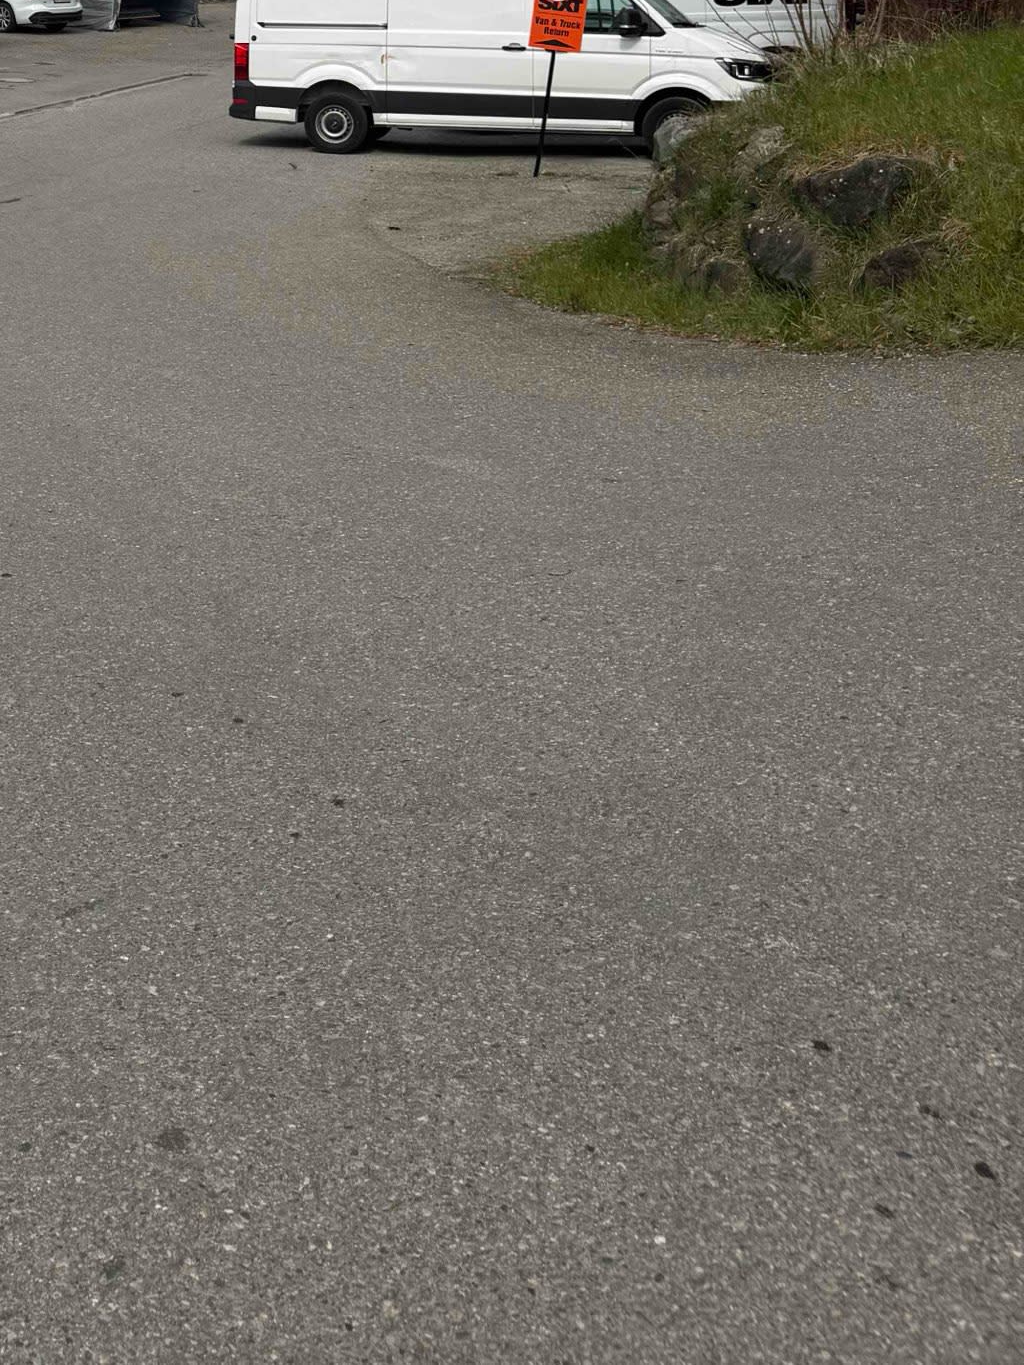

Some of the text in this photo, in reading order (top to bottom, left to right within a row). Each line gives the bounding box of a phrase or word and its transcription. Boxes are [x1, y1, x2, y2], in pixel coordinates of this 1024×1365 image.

[535, 16, 581, 29] Van & Truck
[543, 26, 570, 37] Return
